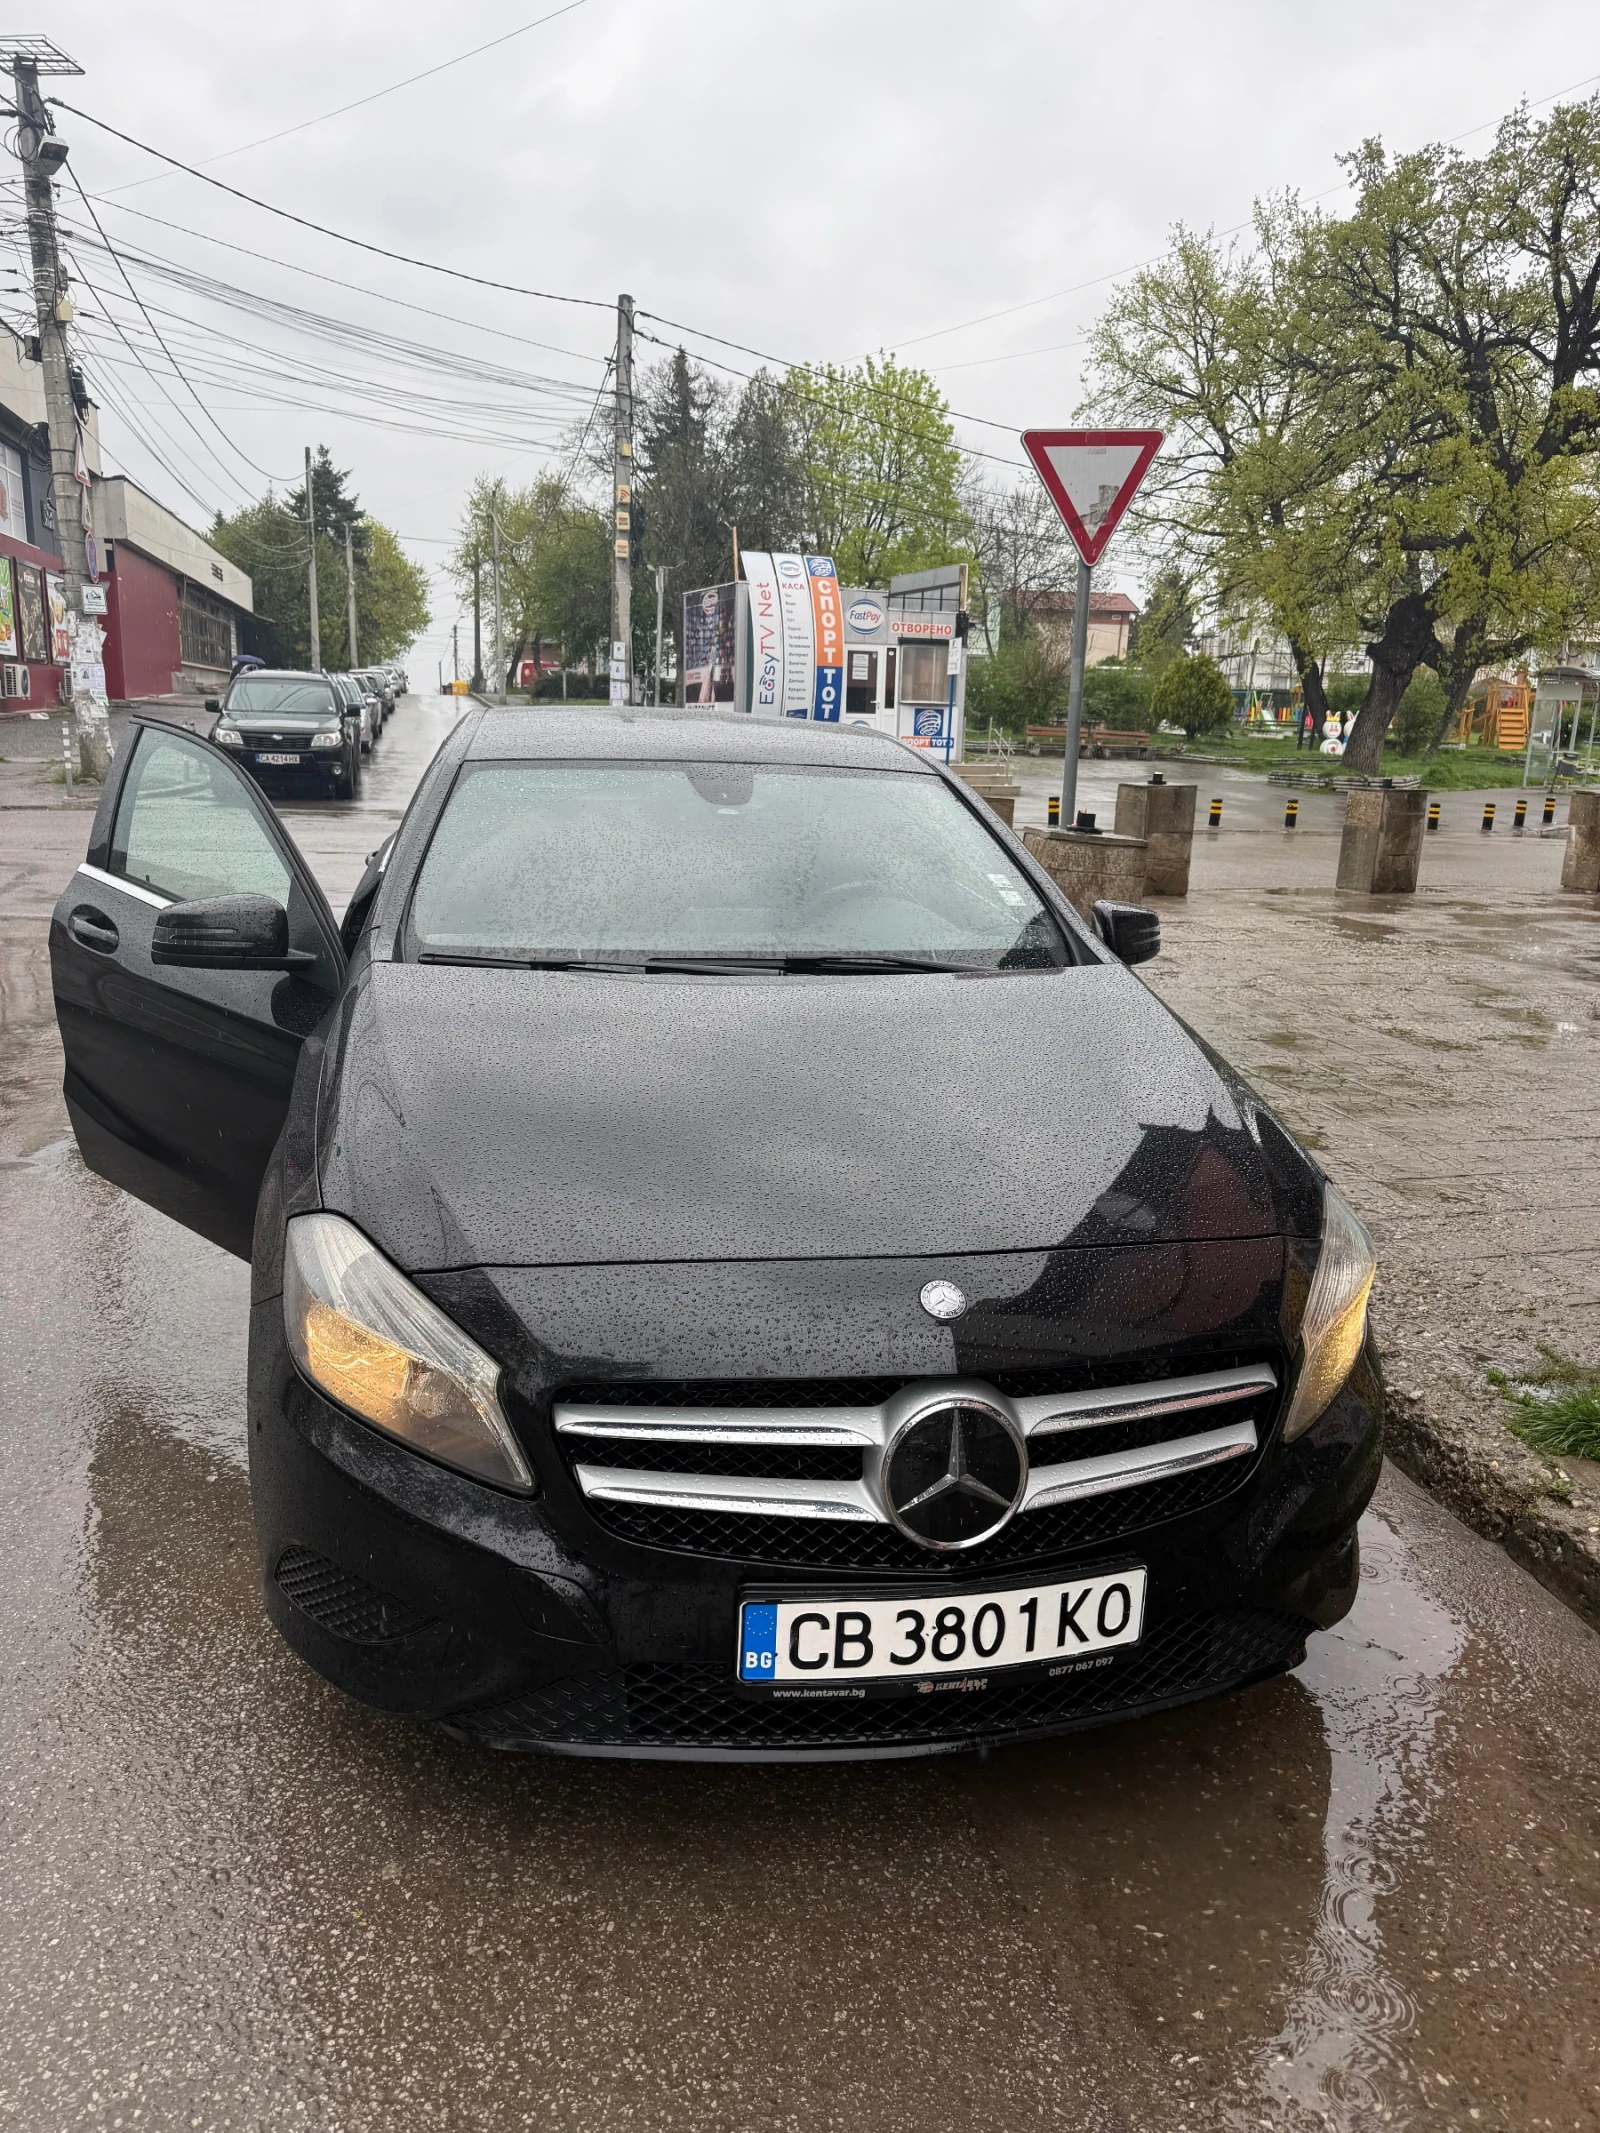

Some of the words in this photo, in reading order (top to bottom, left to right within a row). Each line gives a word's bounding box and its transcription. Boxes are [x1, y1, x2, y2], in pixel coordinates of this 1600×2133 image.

[756, 582, 774, 617] Net
[817, 580, 837, 663] СПОРТ
[850, 610, 881, 624] FastPay
[891, 622, 952, 635] ОТВОРЕНО
[789, 1611, 874, 1670] CB
[889, 1596, 1038, 1666] 3801
[1056, 1582, 1131, 1648] KO
[745, 1651, 773, 1669] BG
[1048, 1665, 1074, 1677] 0877
[1075, 1660, 1094, 1672] 067
[1095, 1656, 1114, 1668] 097
[773, 1687, 866, 1698] www.kentavar.bg
